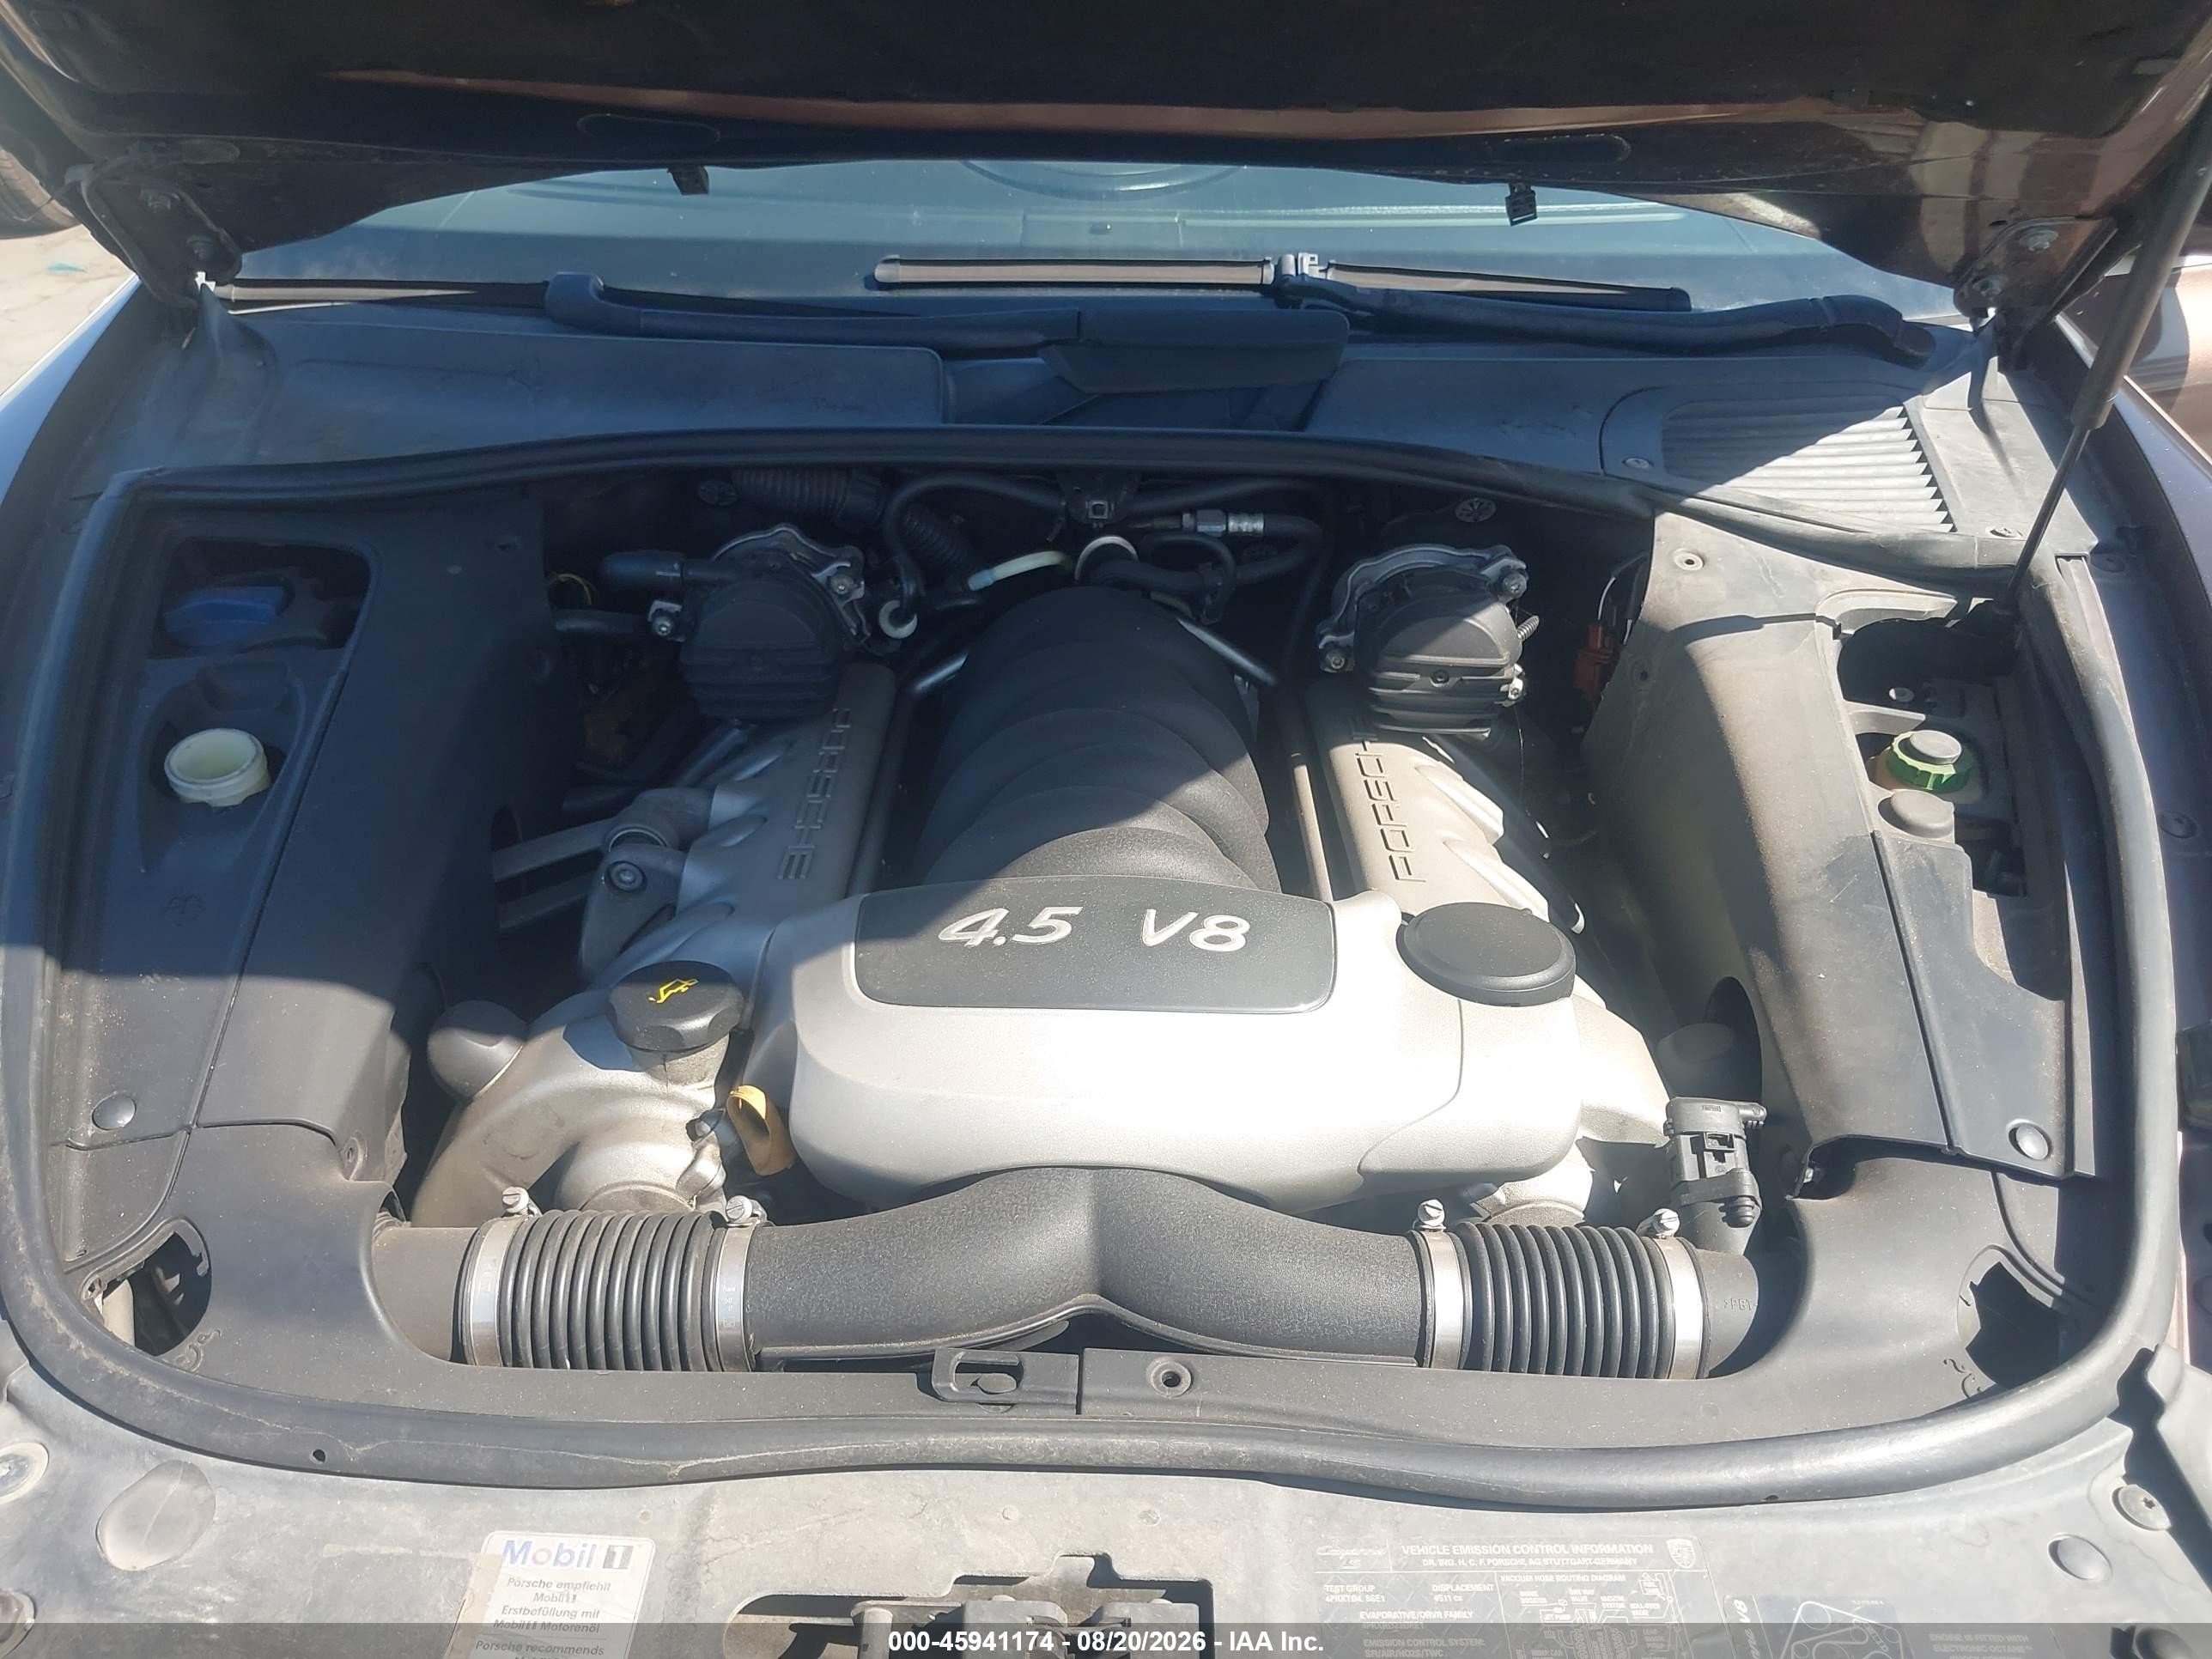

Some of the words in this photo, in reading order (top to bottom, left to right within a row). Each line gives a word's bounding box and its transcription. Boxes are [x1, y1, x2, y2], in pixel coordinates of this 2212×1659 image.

[776, 704, 851, 880] PORSCHE
[938, 906, 1083, 946] 4.5
[1141, 908, 1251, 952] V8
[502, 1540, 598, 1569] Mobil
[1401, 1545, 1451, 1555] VEHICLE
[1452, 1545, 1511, 1555] EMISSION
[1513, 1545, 1571, 1555] CONTROL
[1571, 1544, 1654, 1555] INFORMATION
[507, 1577, 553, 1589] Porsche
[1324, 1584, 1346, 1593] TEST
[1346, 1584, 1376, 1593] GROUP
[1431, 1583, 1496, 1592] DISPLACEMENT
[501, 1605, 577, 1620] Erstbefüllung
[581, 1608, 600, 1619] mit
[540, 1622, 601, 1633] Motorenöl
[475, 1639, 522, 1654] Porsche
[525, 1642, 605, 1656] recommends
[1363, 1638, 1405, 1647] EMISSION
[1406, 1638, 1448, 1647] CONTROL
